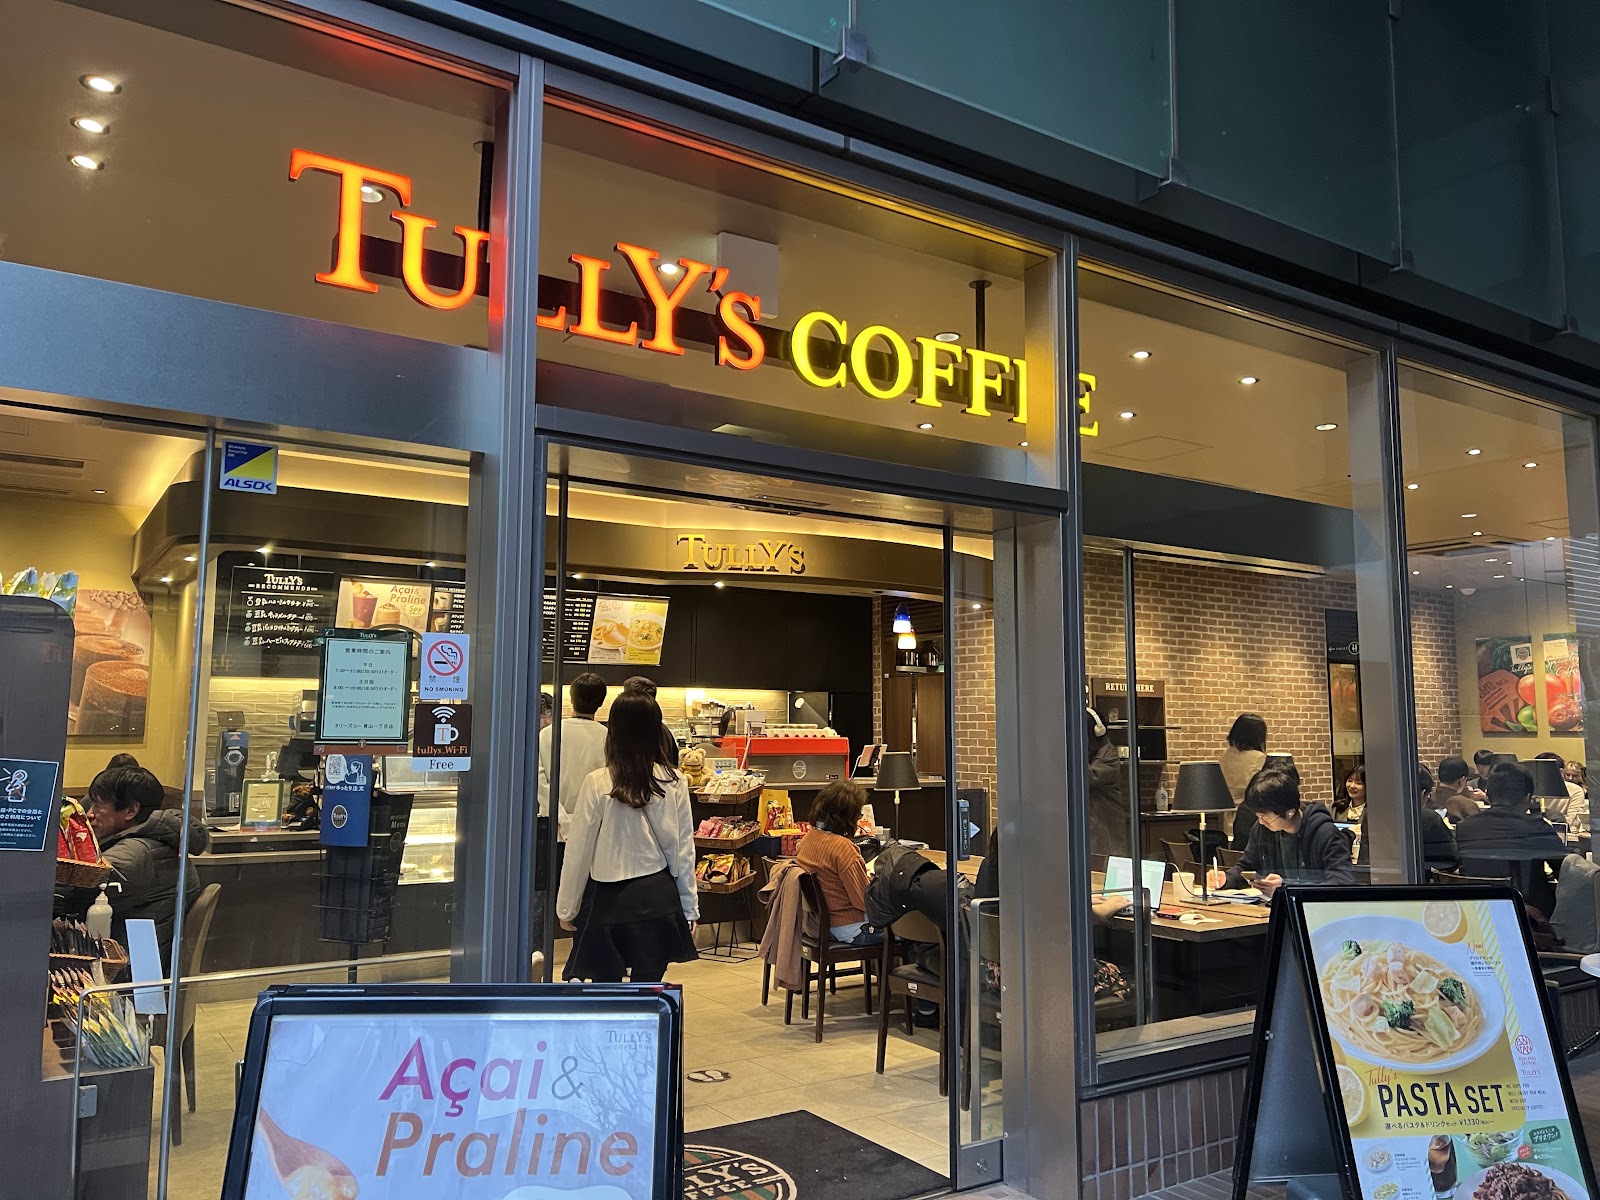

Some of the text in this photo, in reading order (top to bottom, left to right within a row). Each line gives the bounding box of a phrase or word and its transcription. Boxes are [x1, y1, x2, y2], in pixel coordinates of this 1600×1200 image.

[289, 149, 764, 370] TULY'S
[224, 479, 273, 491] ALSOK
[677, 533, 805, 573] TULLY'S
[264, 574, 304, 586] TULLY'S
[255, 583, 311, 591] RECOMMENDS
[390, 584, 414, 596] Açai
[390, 594, 427, 604] Praline
[1105, 682, 1127, 691] RETU
[429, 759, 454, 770] Free
[606, 1030, 651, 1042] TULLY'S
[379, 1037, 584, 1117] Açai &
[1366, 1066, 1397, 1087] Tully's
[1378, 1082, 1504, 1117] PASTA SET
[375, 1108, 638, 1177] Praline
